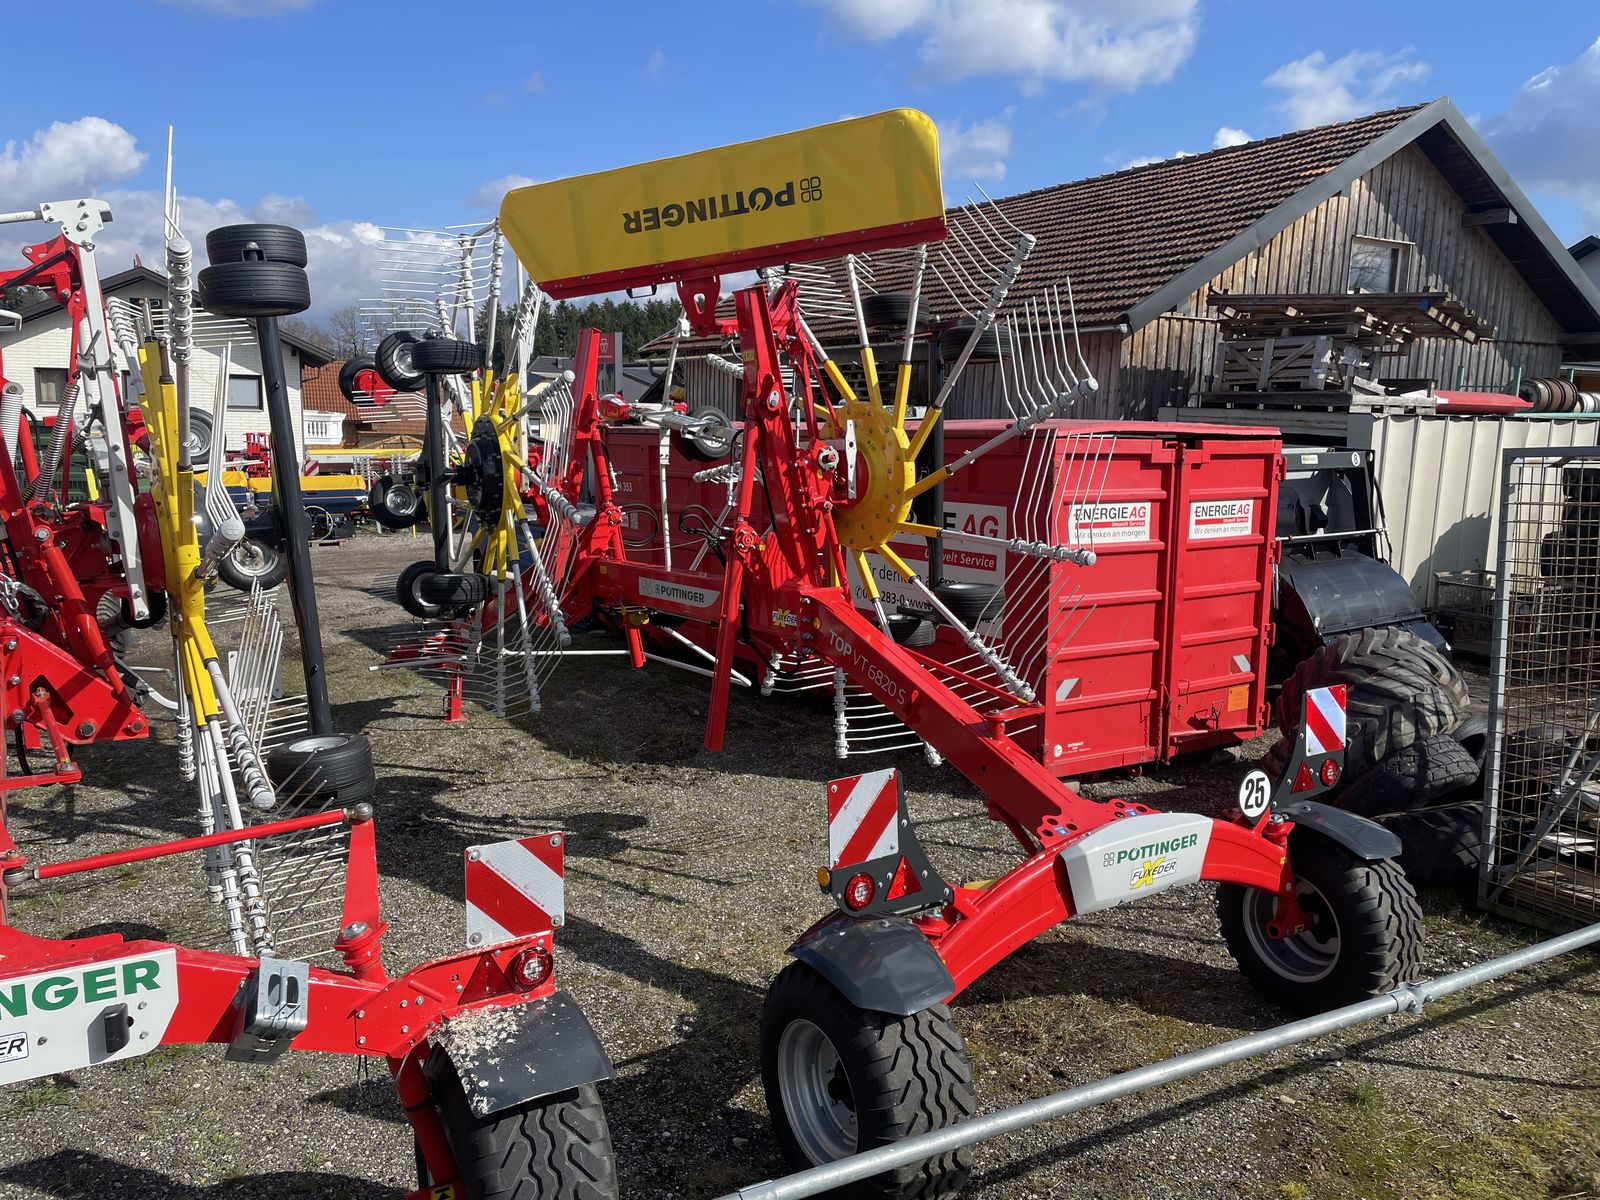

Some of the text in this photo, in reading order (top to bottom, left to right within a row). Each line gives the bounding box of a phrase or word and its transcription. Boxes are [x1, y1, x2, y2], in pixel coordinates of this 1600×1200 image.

[1074, 506, 1147, 521] ENERGIE AG
[1194, 503, 1250, 517] ENERGIE AG
[961, 513, 999, 539] AG
[960, 552, 995, 568] Service
[829, 630, 907, 705] TOP VT 6820 S
[1244, 776, 1266, 810] 25
